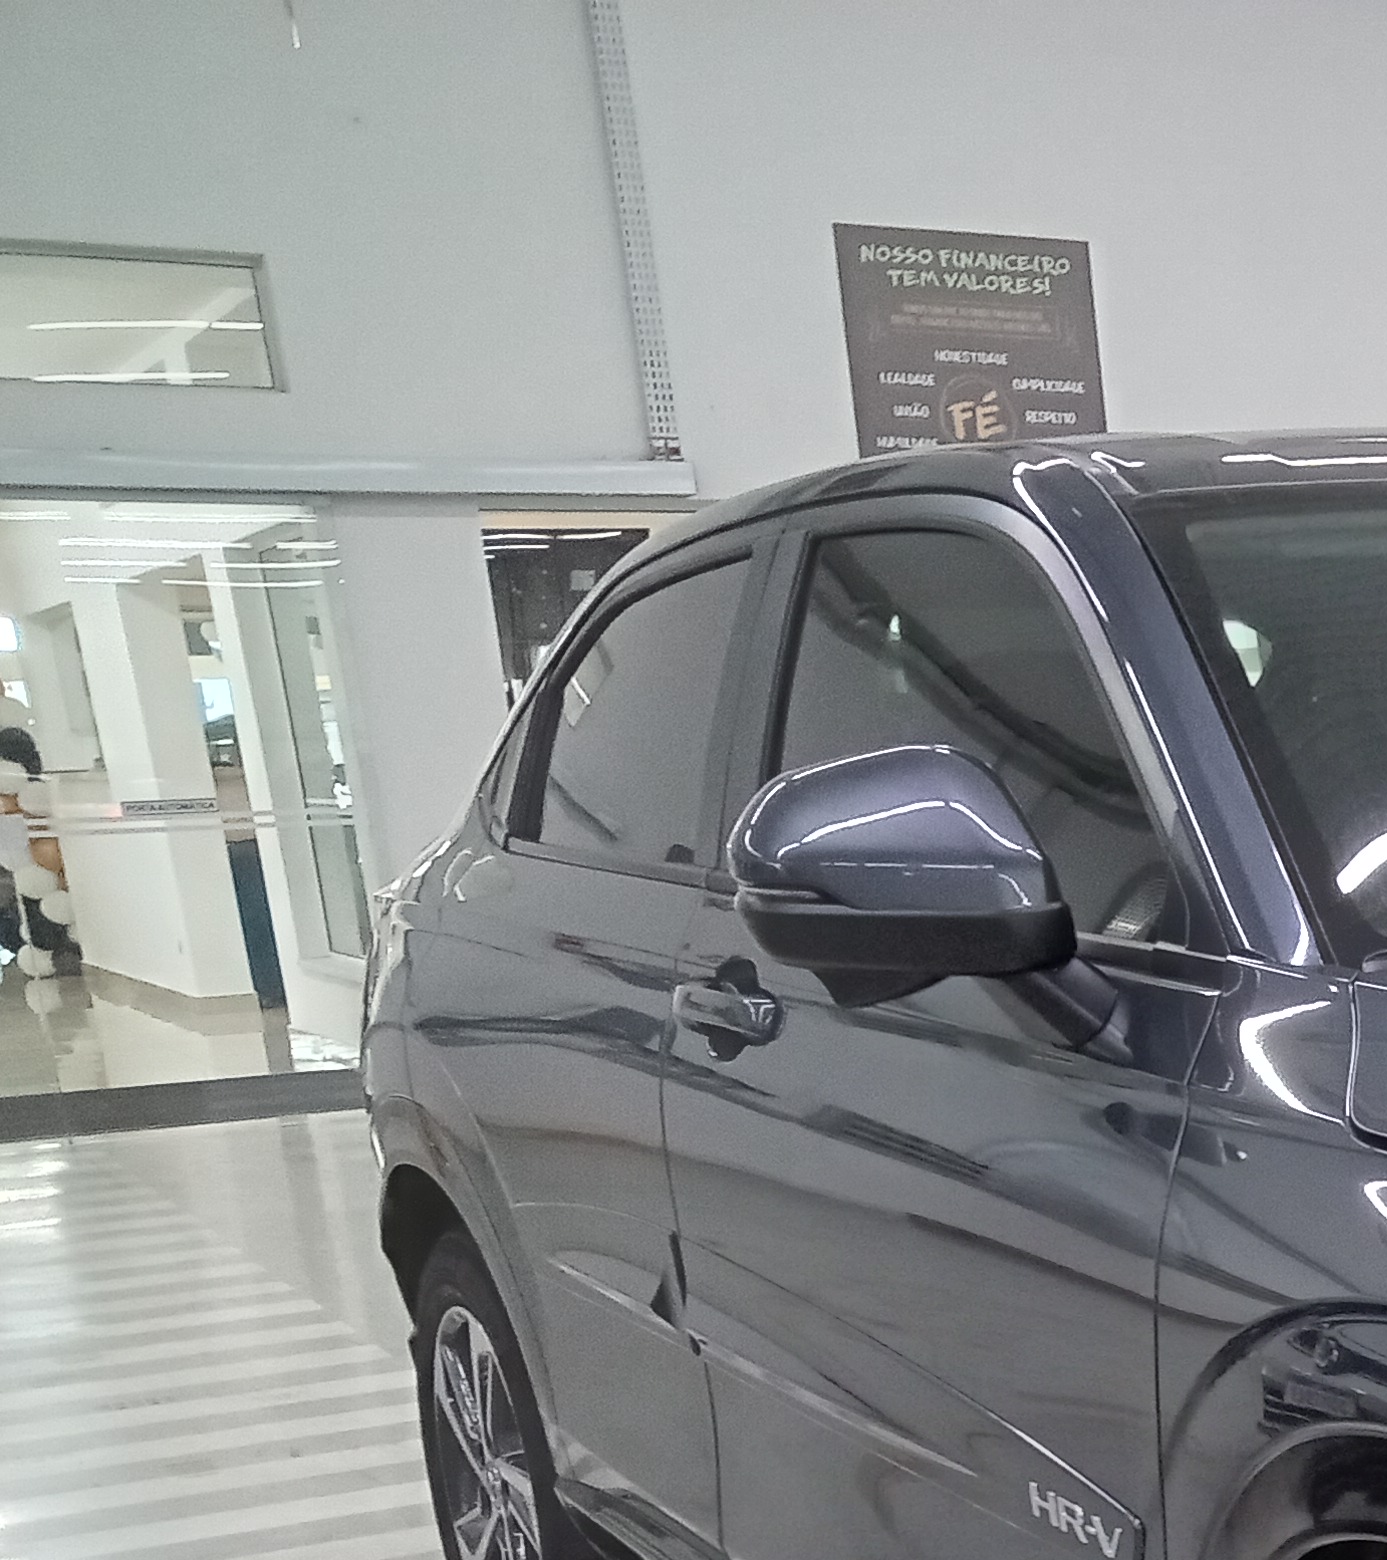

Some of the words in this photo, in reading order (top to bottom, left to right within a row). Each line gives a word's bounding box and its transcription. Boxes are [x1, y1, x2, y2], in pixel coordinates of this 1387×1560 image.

[858, 242, 933, 264] NOSSO
[937, 248, 1072, 277] FINANCEIRO
[887, 268, 940, 288] TEM
[942, 271, 1052, 296] VALORES!
[947, 390, 1007, 441] FÉ
[1029, 1481, 1123, 1559] HR-V
